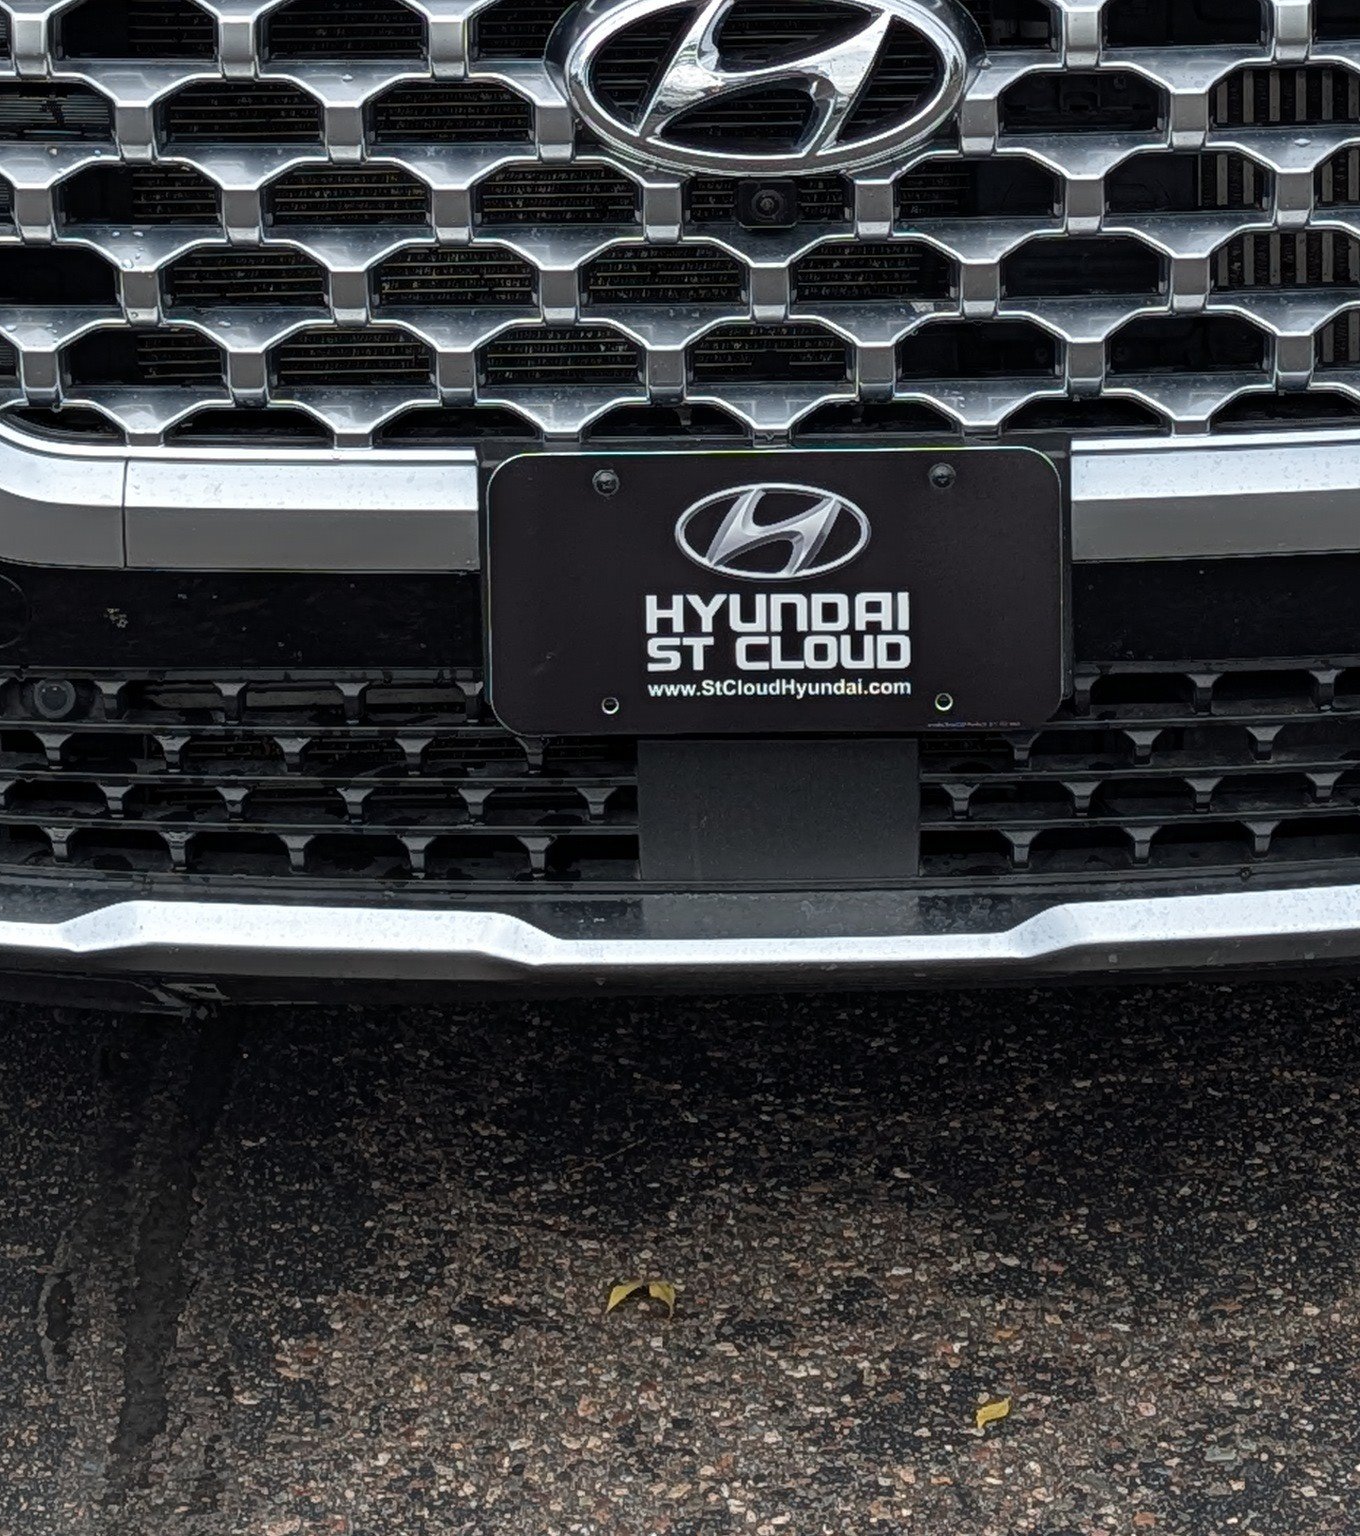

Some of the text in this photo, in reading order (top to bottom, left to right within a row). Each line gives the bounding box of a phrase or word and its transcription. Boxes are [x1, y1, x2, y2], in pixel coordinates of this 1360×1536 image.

[645, 591, 910, 634] HYUNDAI
[646, 634, 912, 672] ST CLOUD
[647, 678, 912, 699] www.StCloudHyundai.com
